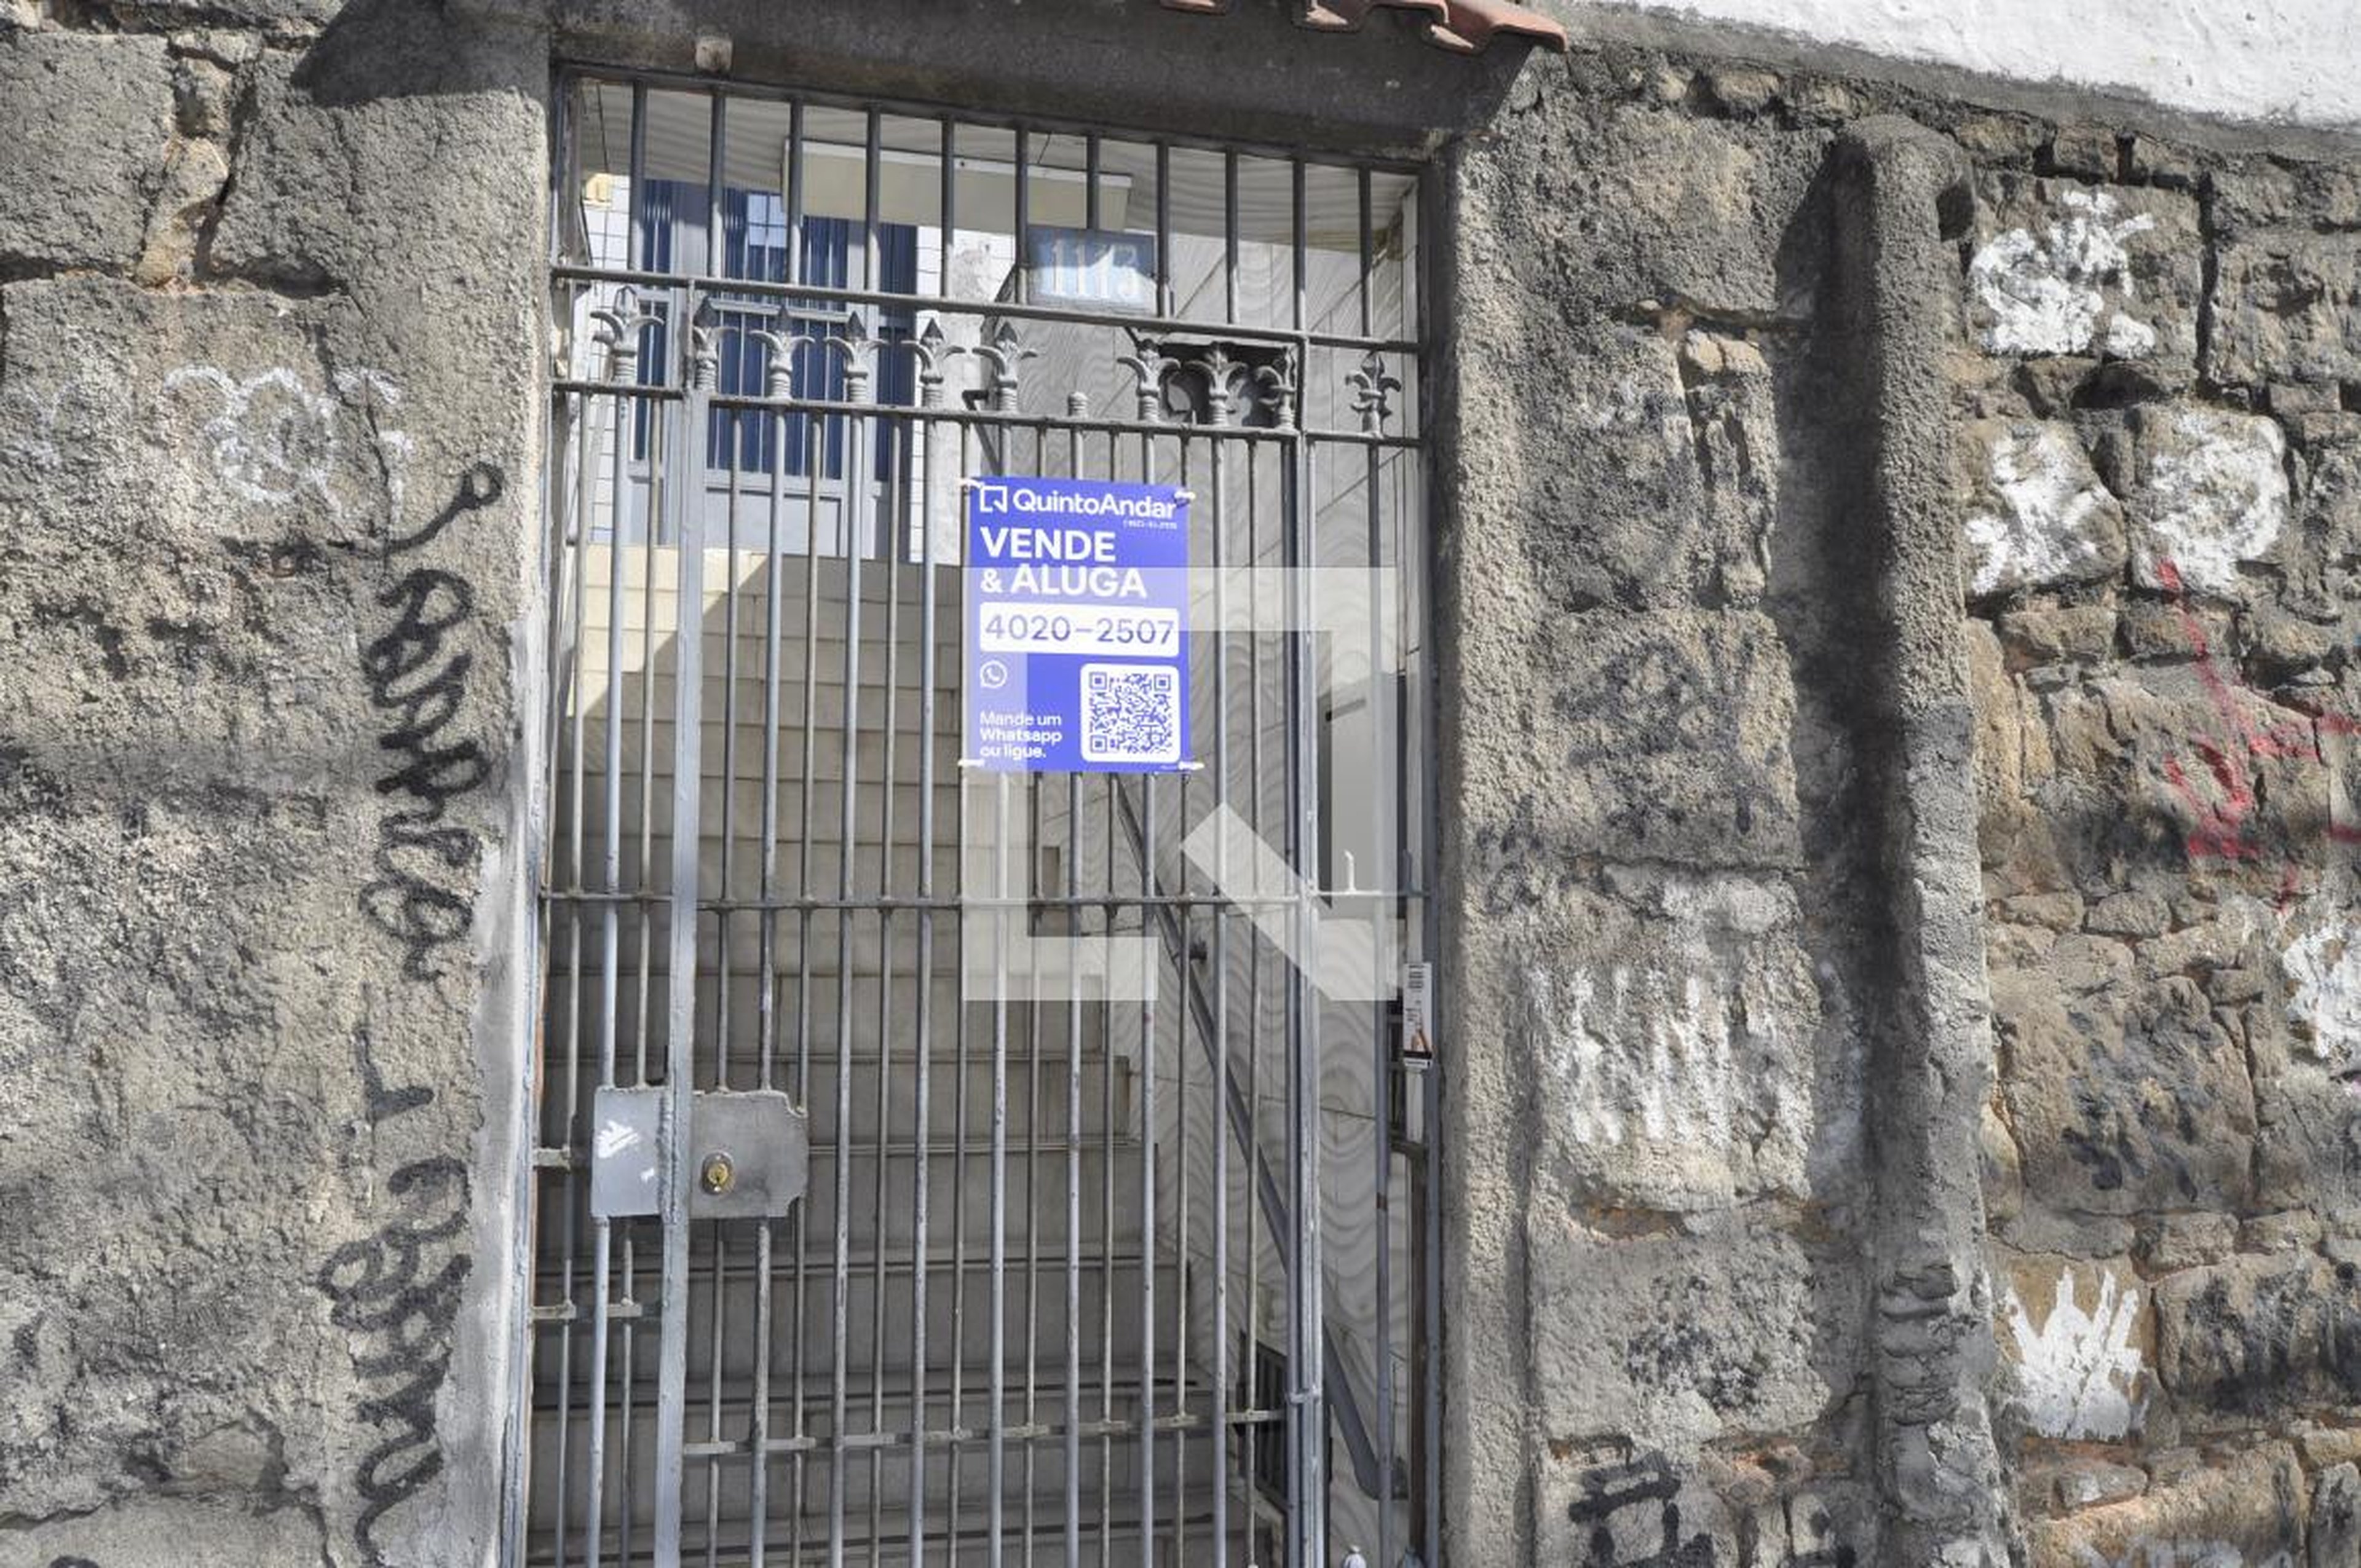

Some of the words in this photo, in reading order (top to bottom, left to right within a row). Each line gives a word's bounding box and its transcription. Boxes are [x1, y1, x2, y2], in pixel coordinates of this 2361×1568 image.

[1013, 488, 1177, 519] QuintoAndar
[980, 526, 1116, 562] VENDE
[980, 568, 1002, 594] &
[1010, 563, 1148, 599] ALUGA
[985, 613, 1175, 645] 4020-2507
[979, 711, 1034, 726] Mande
[1037, 715, 1062, 726] um
[979, 727, 1062, 747] Whatsapp
[980, 746, 1000, 757] ou
[1003, 743, 1046, 760] ligue.
